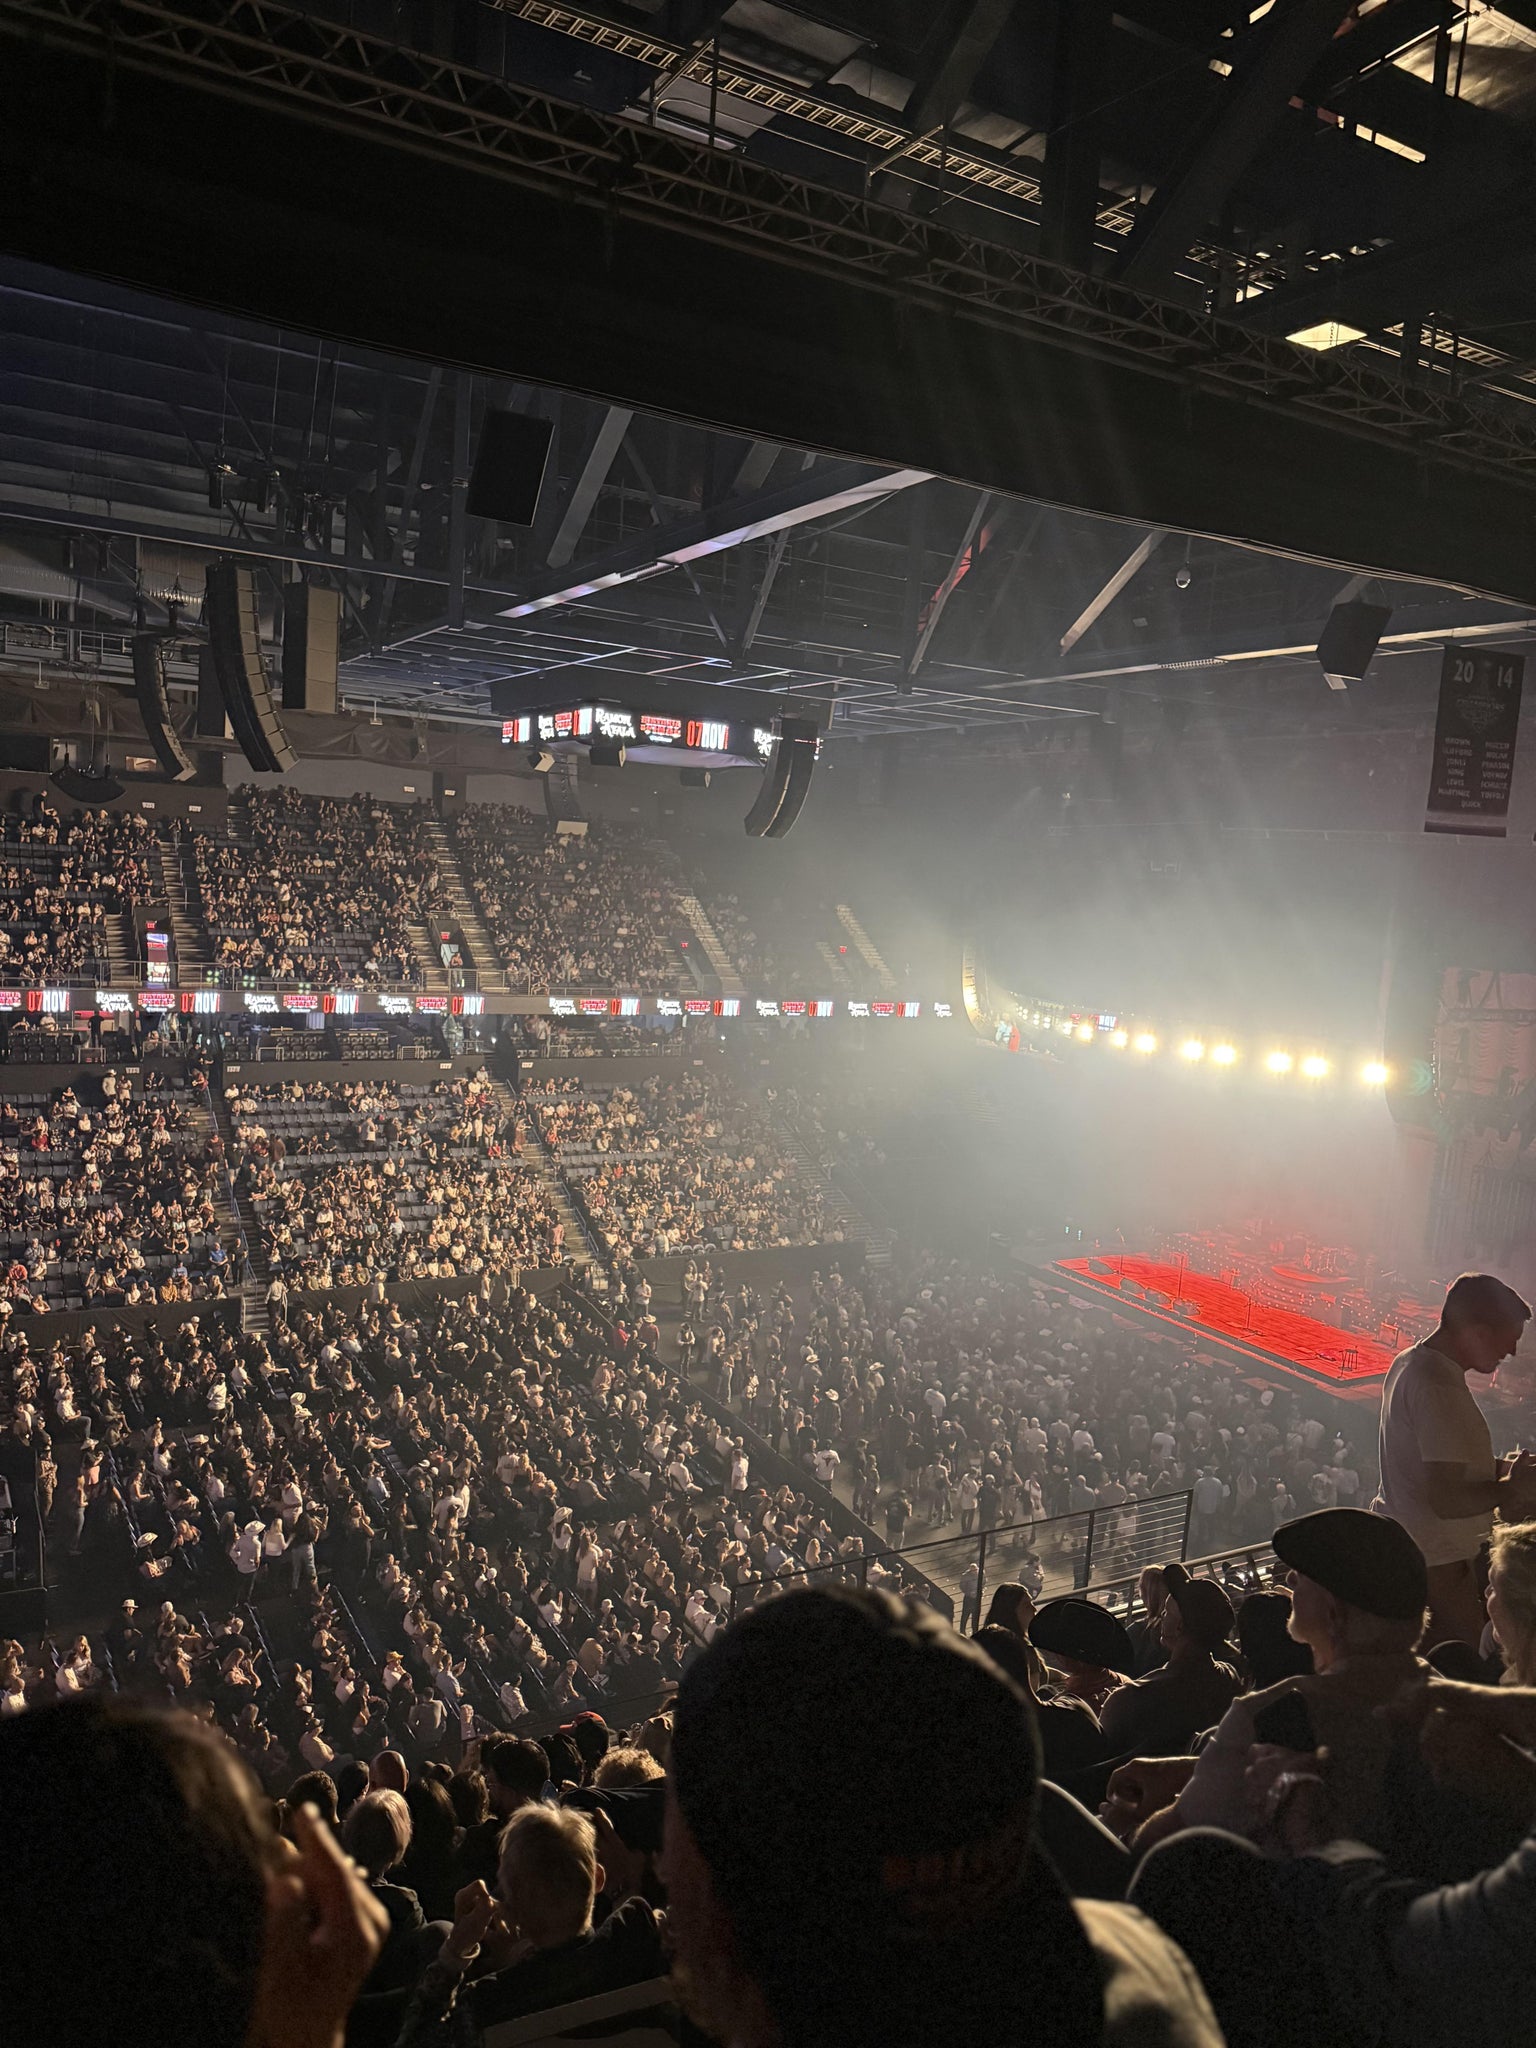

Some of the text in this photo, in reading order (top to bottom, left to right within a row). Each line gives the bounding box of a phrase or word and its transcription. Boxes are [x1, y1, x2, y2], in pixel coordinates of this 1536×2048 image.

[1453, 659, 1513, 689] 20 14
[96, 991, 129, 1003] RAMON
